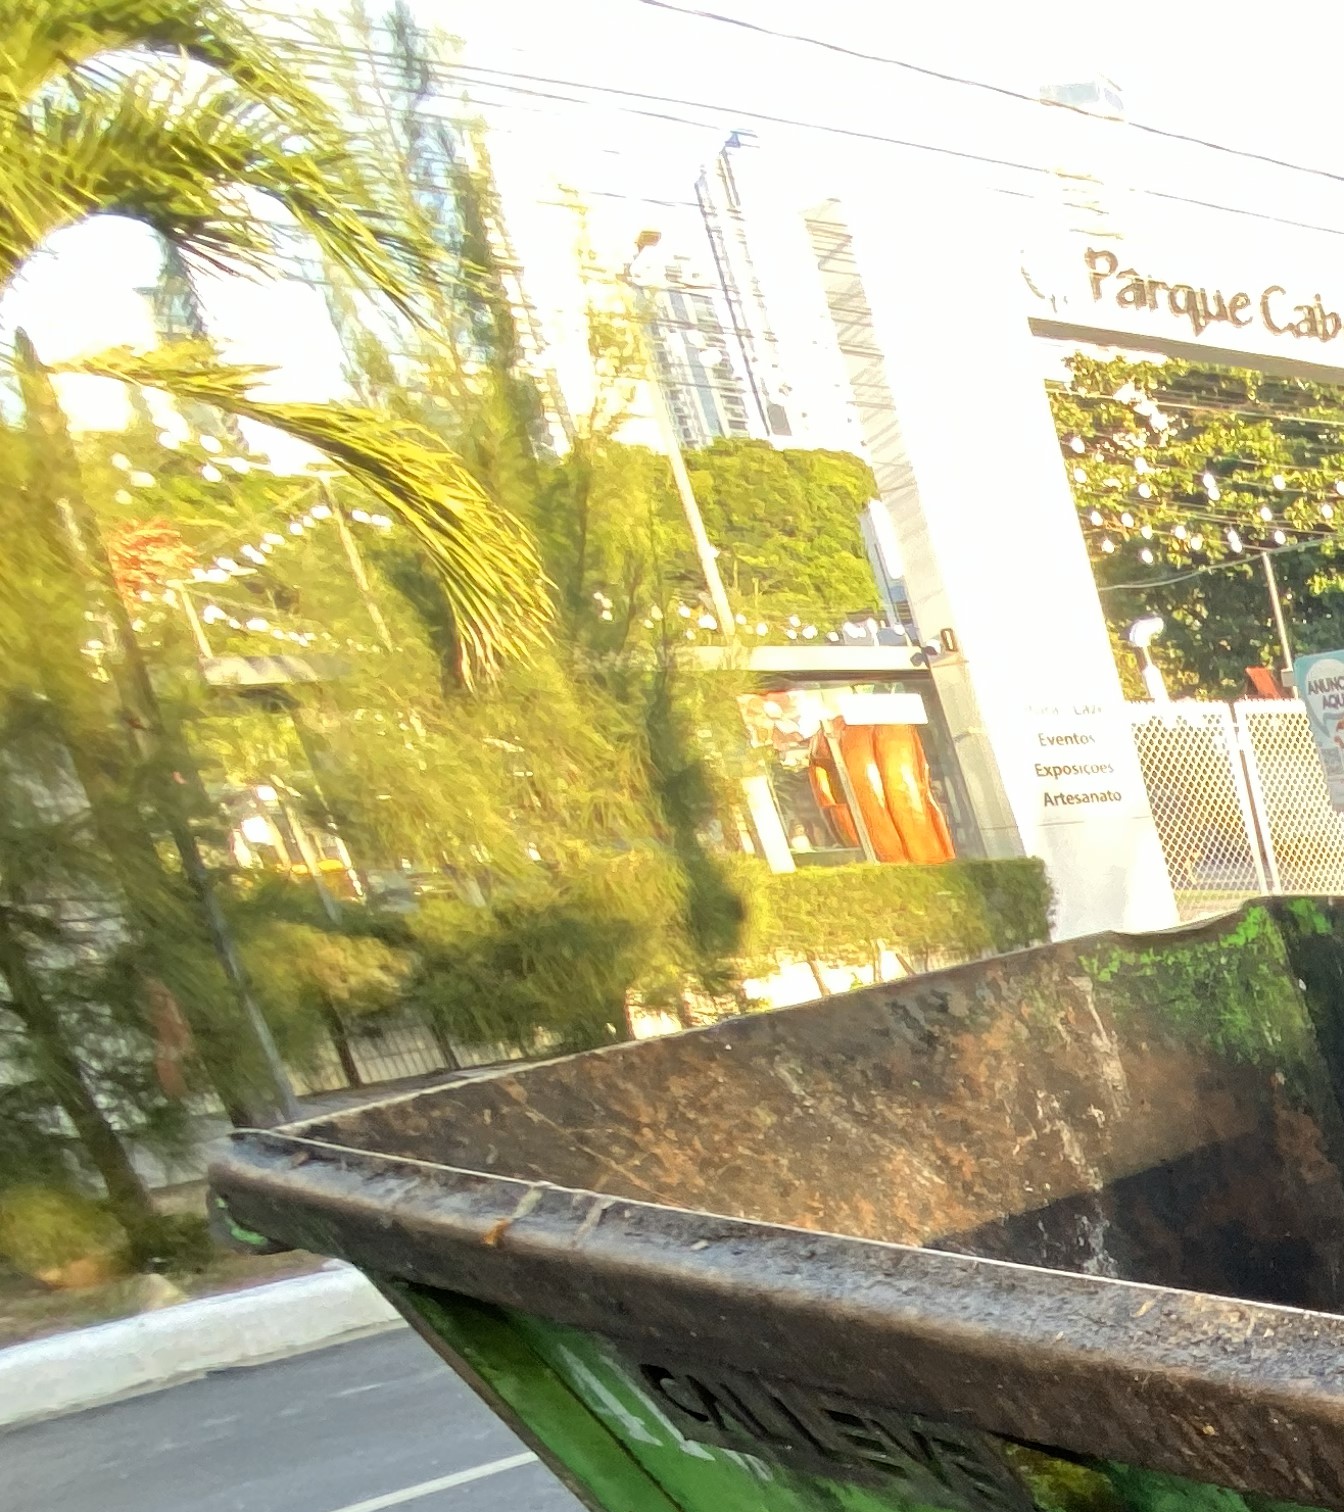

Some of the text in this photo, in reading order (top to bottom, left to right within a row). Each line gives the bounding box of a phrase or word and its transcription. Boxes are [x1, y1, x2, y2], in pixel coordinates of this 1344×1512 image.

[1083, 246, 1253, 338] Parque
[1038, 732, 1096, 746] Eventos
[1043, 790, 1122, 807] Artesanato
